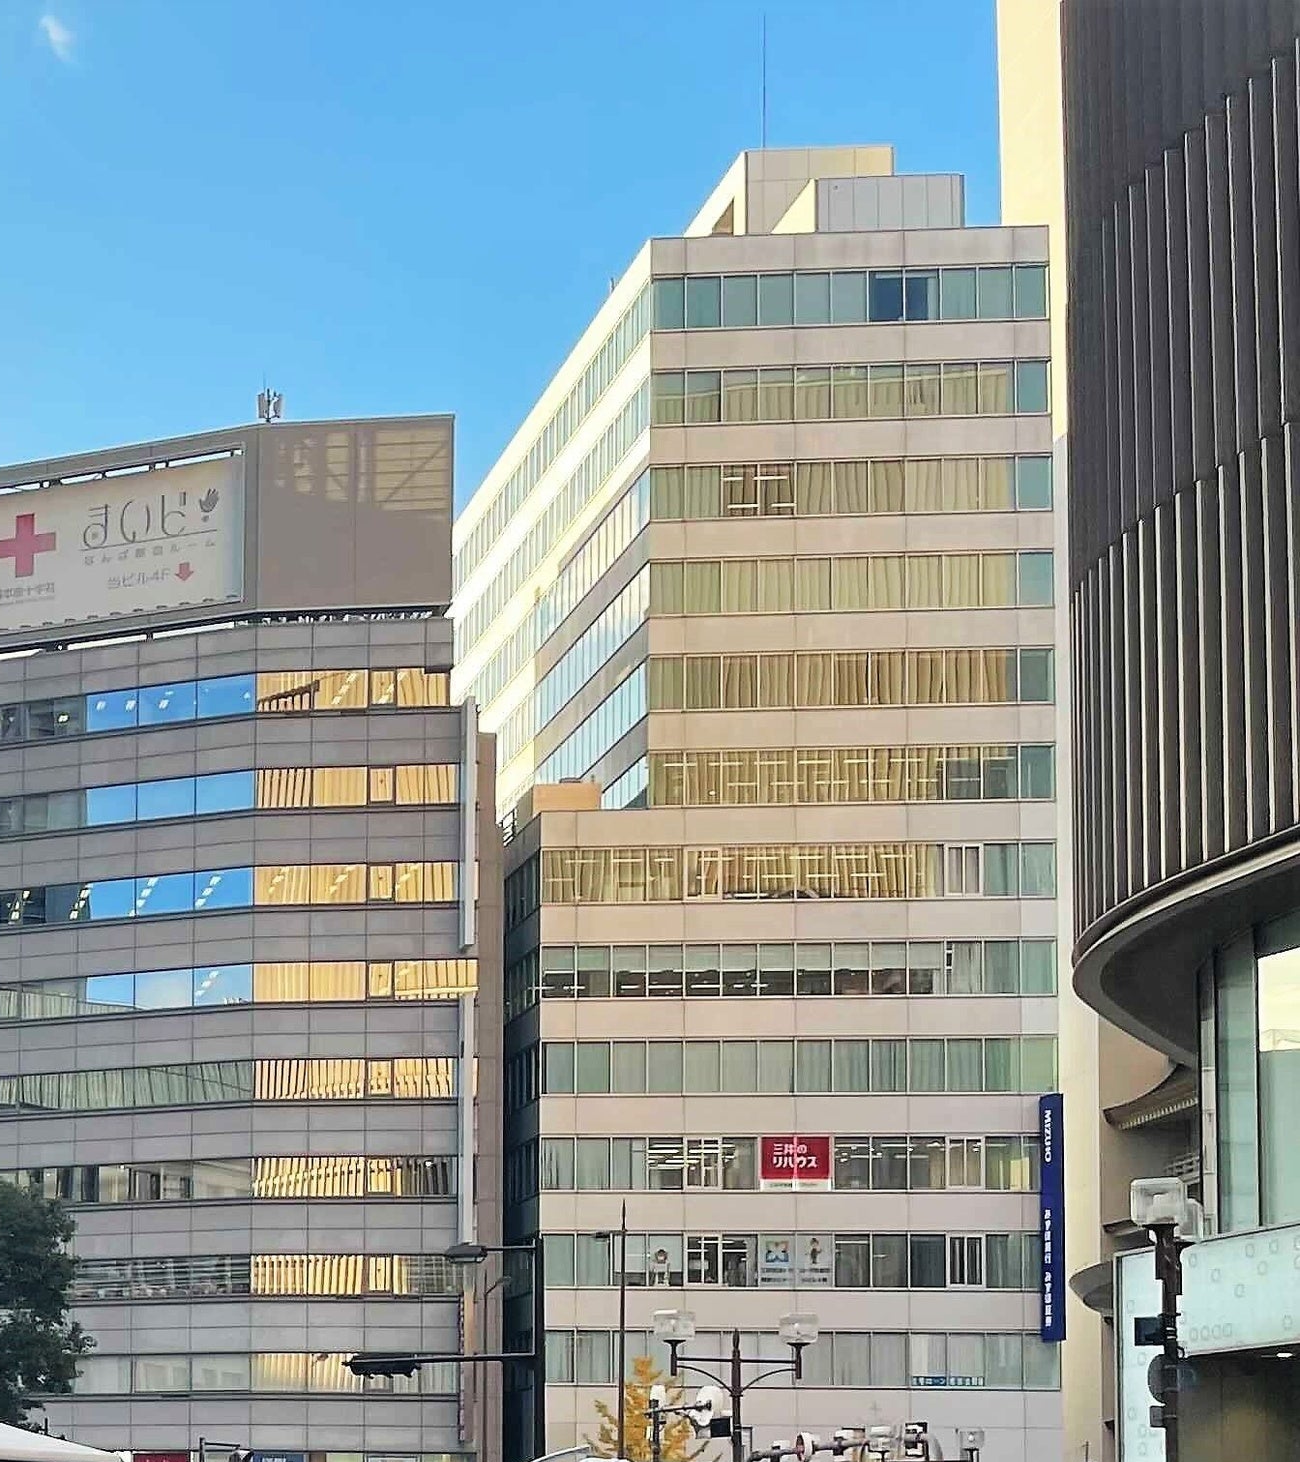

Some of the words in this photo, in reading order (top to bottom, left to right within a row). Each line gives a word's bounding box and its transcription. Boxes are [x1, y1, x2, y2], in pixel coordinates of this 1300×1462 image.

[1043, 1109, 1052, 1163] MIZUHO
[772, 1143, 808, 1156] 三井の
[772, 1156, 818, 1169] リハウス
